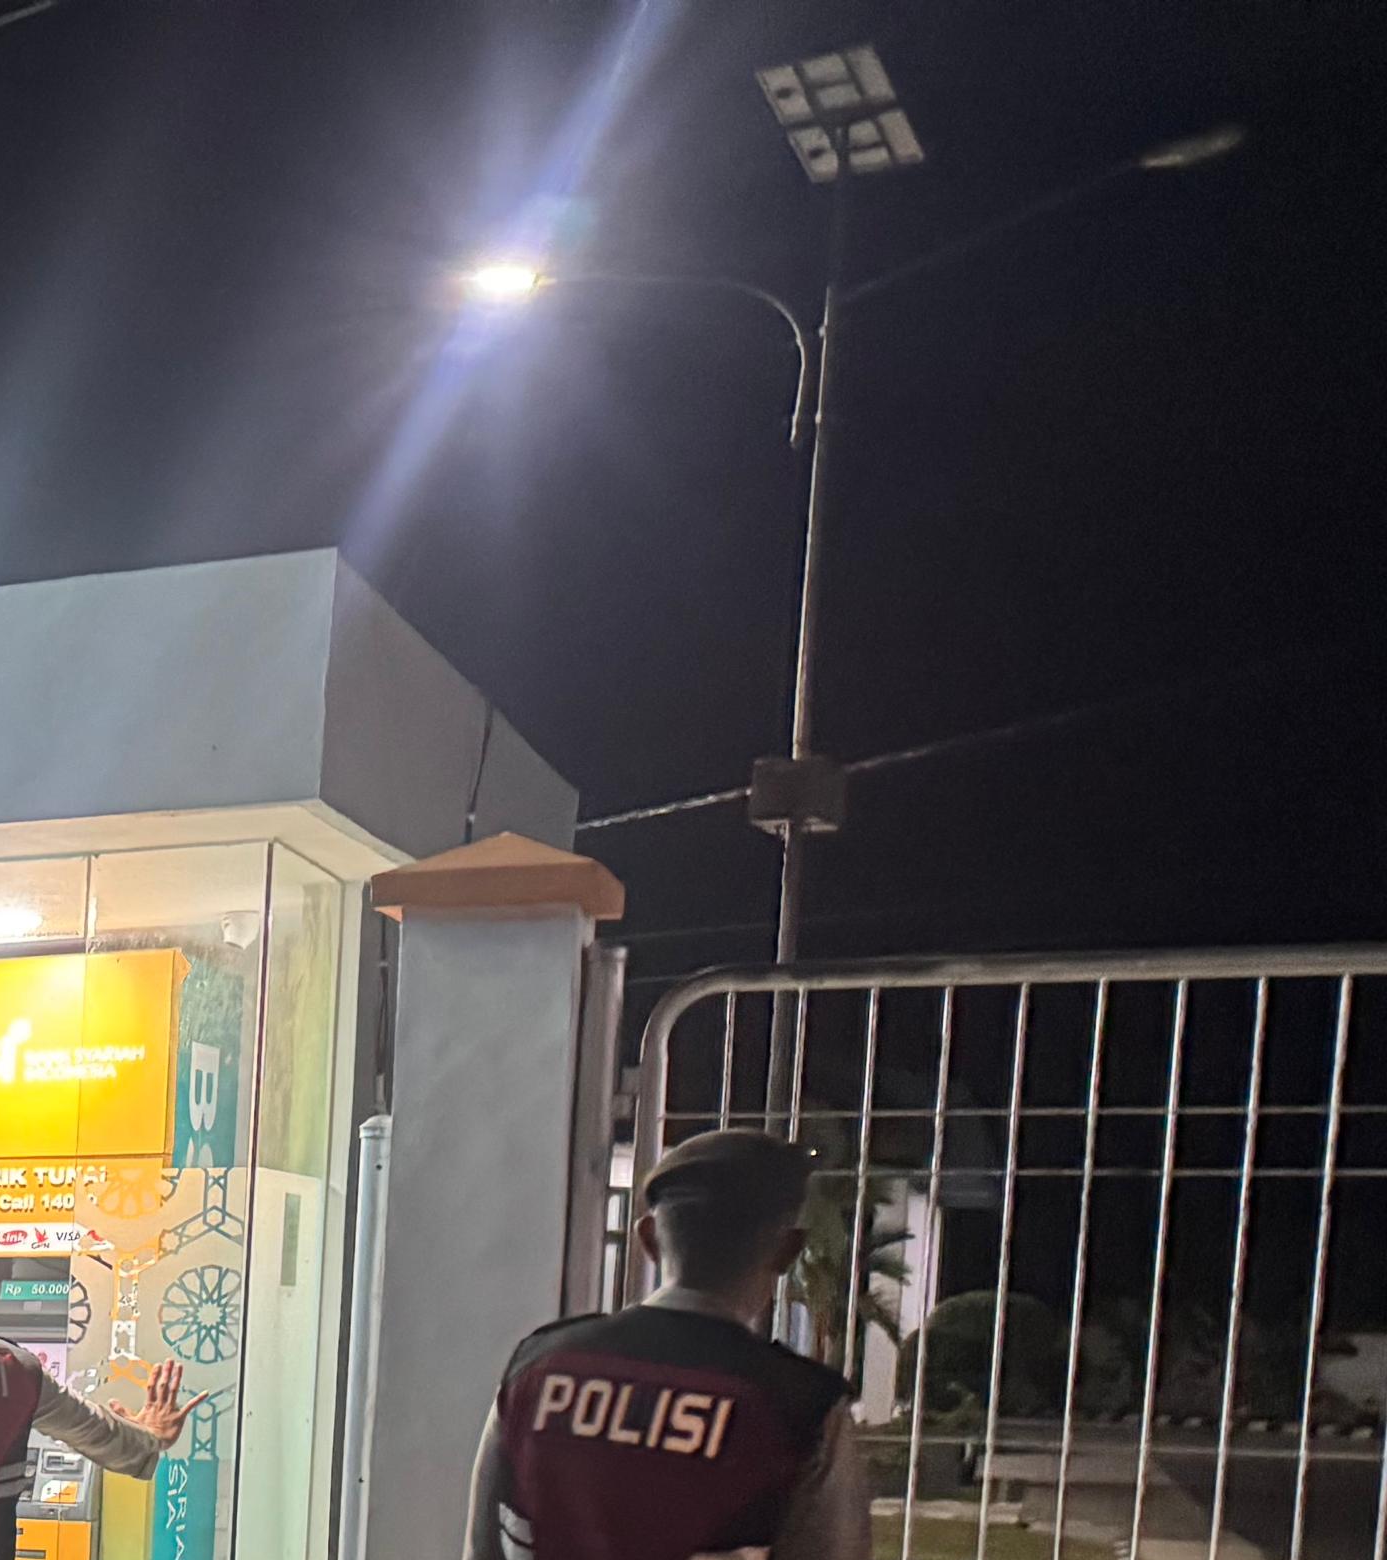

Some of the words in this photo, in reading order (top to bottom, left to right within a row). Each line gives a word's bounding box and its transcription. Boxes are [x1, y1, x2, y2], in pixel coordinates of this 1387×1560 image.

[5, 1284, 22, 1296] Rp
[31, 1283, 70, 1295] 50.000
[533, 1374, 736, 1459] POLISI
